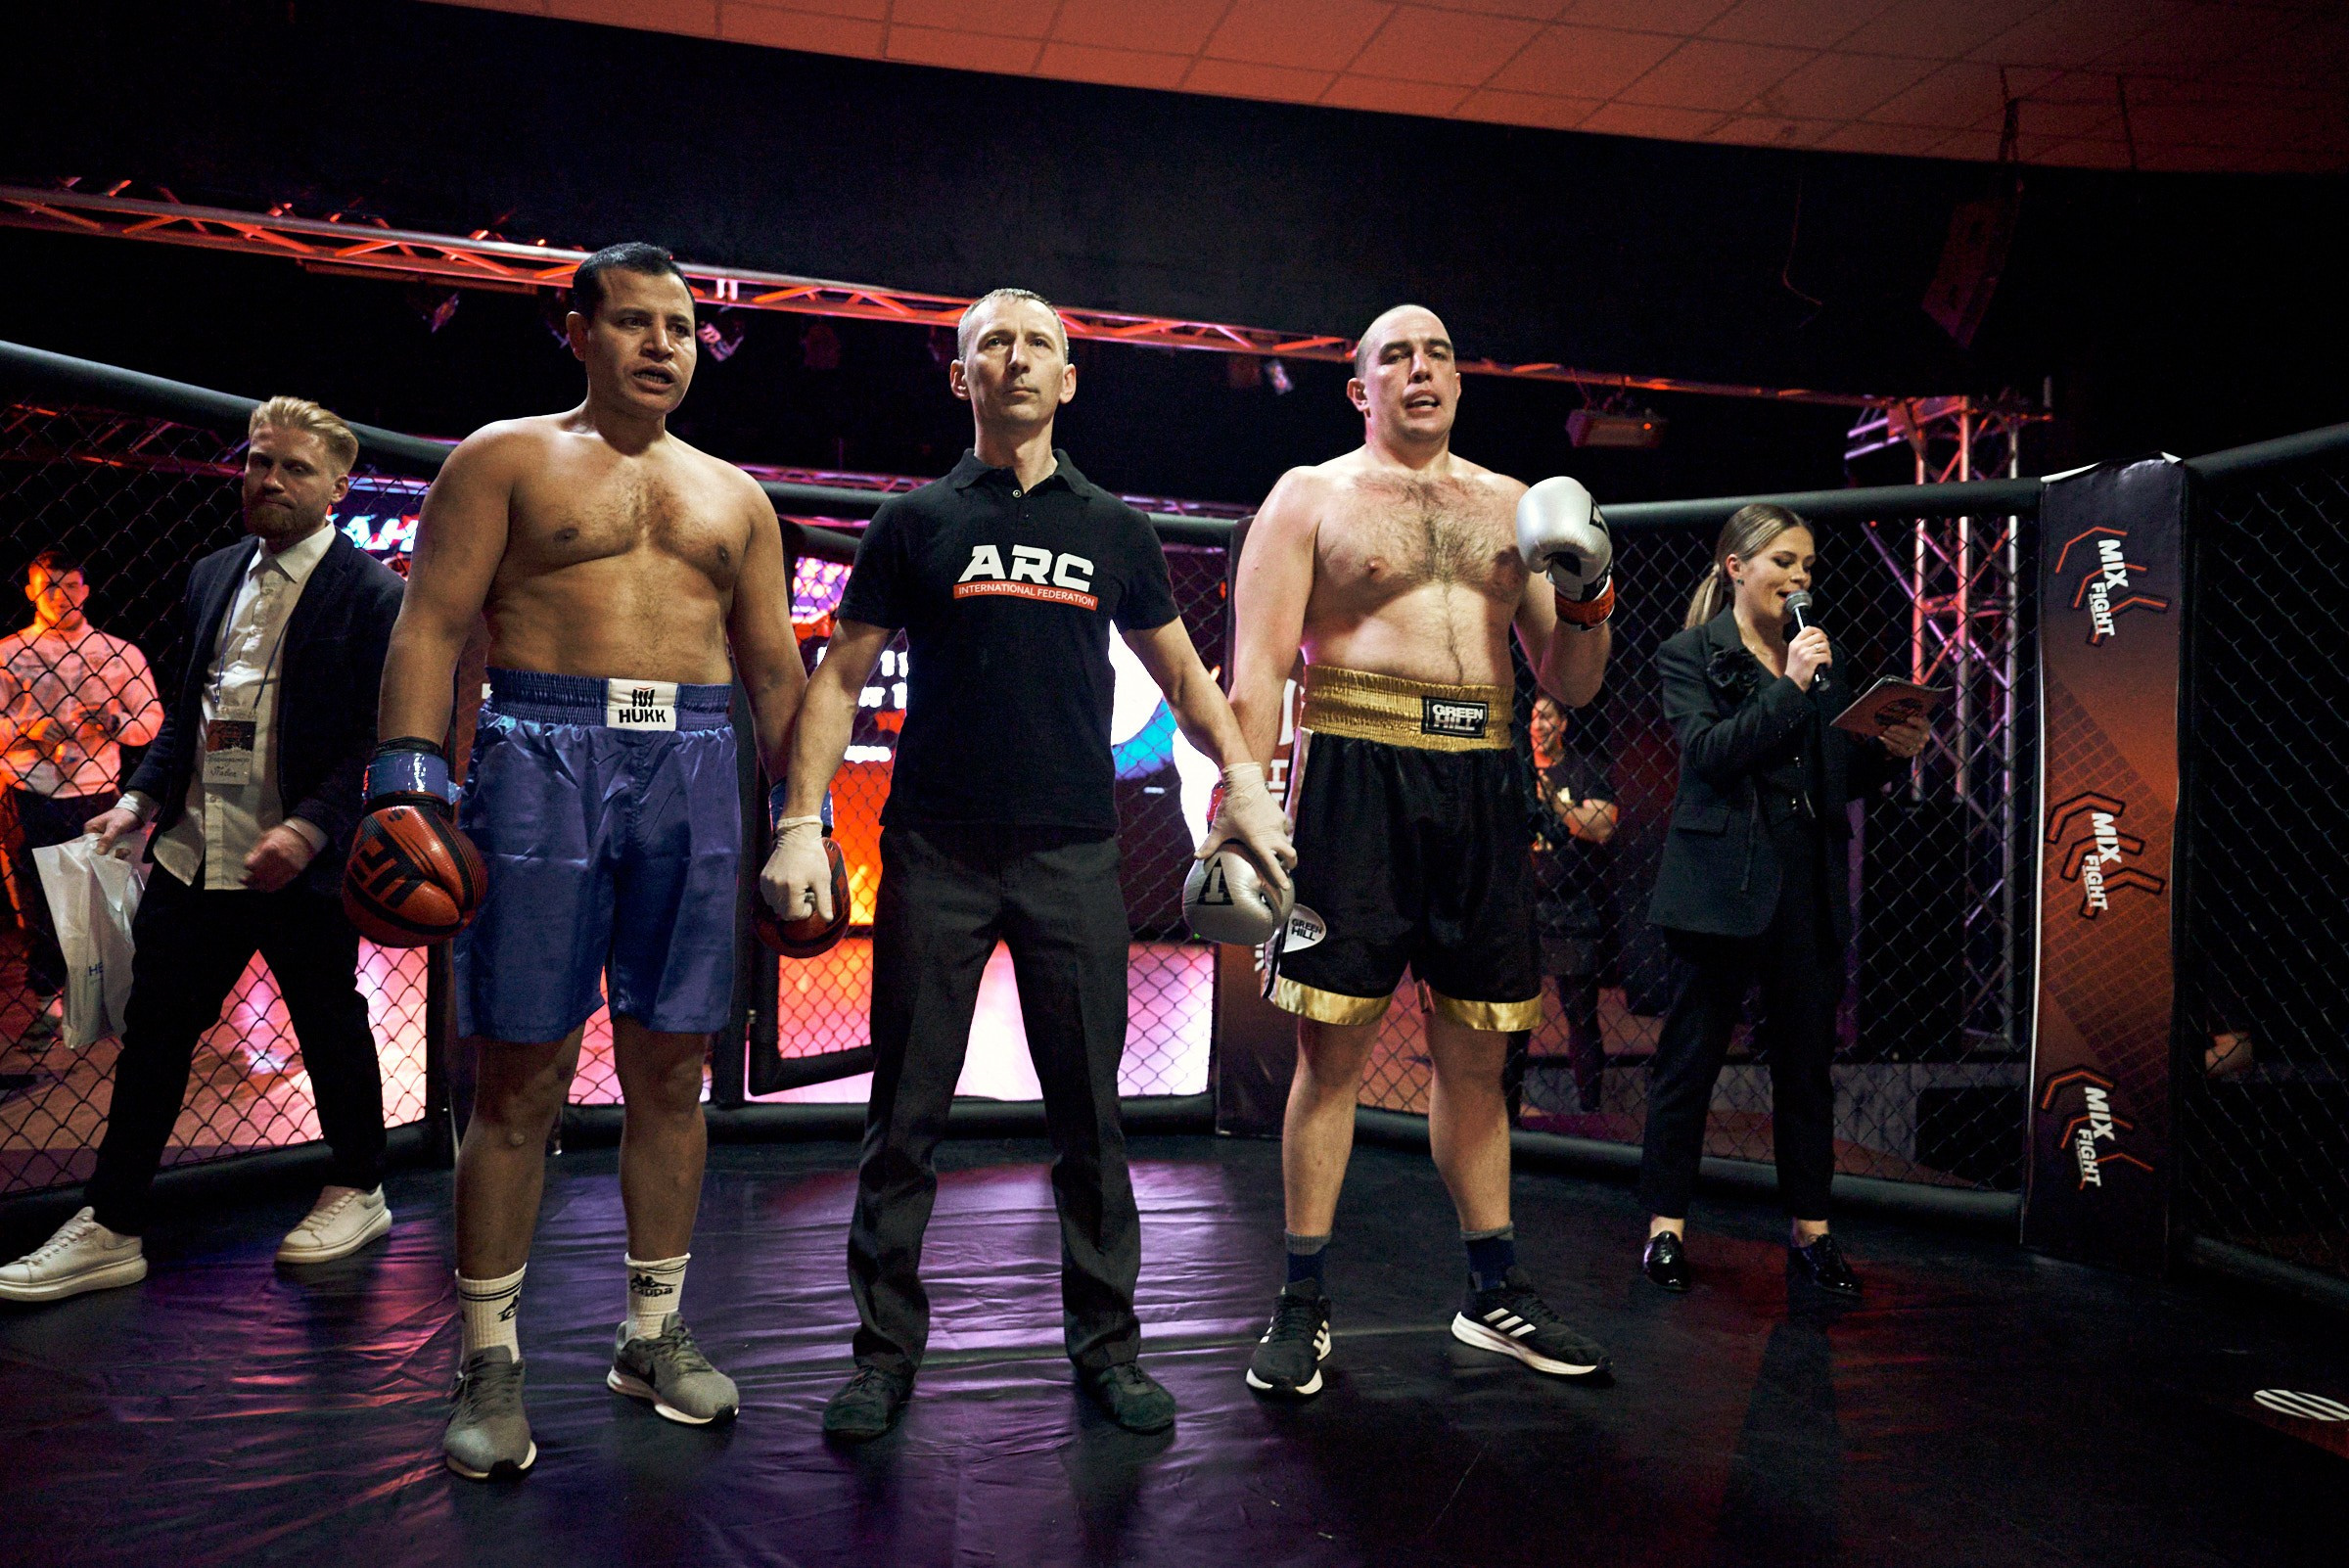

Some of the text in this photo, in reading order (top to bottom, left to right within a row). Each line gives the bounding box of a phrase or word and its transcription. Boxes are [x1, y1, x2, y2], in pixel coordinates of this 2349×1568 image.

[957, 544, 1094, 593] ARC
[2097, 539, 2129, 590] MIX
[958, 583, 1095, 607] INTERNATIONAL FEDERATION
[2091, 581, 2115, 636] FIGHT
[619, 709, 667, 723] HUKK
[1432, 704, 1484, 720] GREEN
[1433, 715, 1476, 731] HILL
[2091, 812, 2122, 864] MIX
[2085, 854, 2108, 910] FIGHT
[1291, 918, 1321, 935] GREEN
[1291, 926, 1316, 942] HILL
[2085, 1086, 2115, 1141] MIX
[2077, 1129, 2101, 1187] FIGHT
